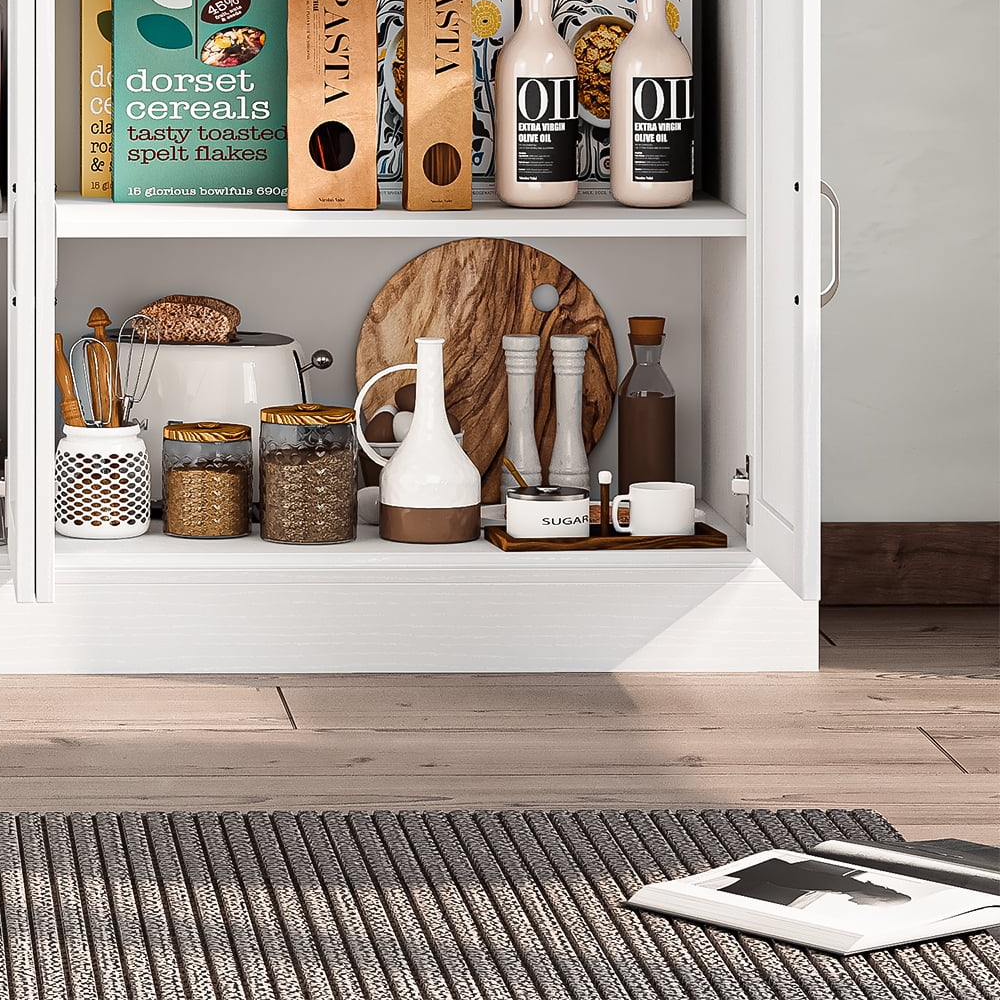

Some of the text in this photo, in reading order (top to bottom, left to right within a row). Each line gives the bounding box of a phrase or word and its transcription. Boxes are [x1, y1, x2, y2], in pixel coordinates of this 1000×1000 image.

[126, 68, 255, 93] dorset
[126, 96, 270, 120] cereals
[518, 122, 566, 131] EXTRA VIRGIN
[634, 122, 682, 131] EXTRA VIRGIN
[127, 125, 288, 144] tasty toasted
[518, 133, 551, 142] OLIVE OIL
[634, 133, 668, 142] OLIVE OIL
[127, 145, 268, 164] spelt flakes
[145, 186, 196, 198] glorious
[200, 187, 253, 196] bowlfuls
[541, 514, 589, 525] SUGAR
